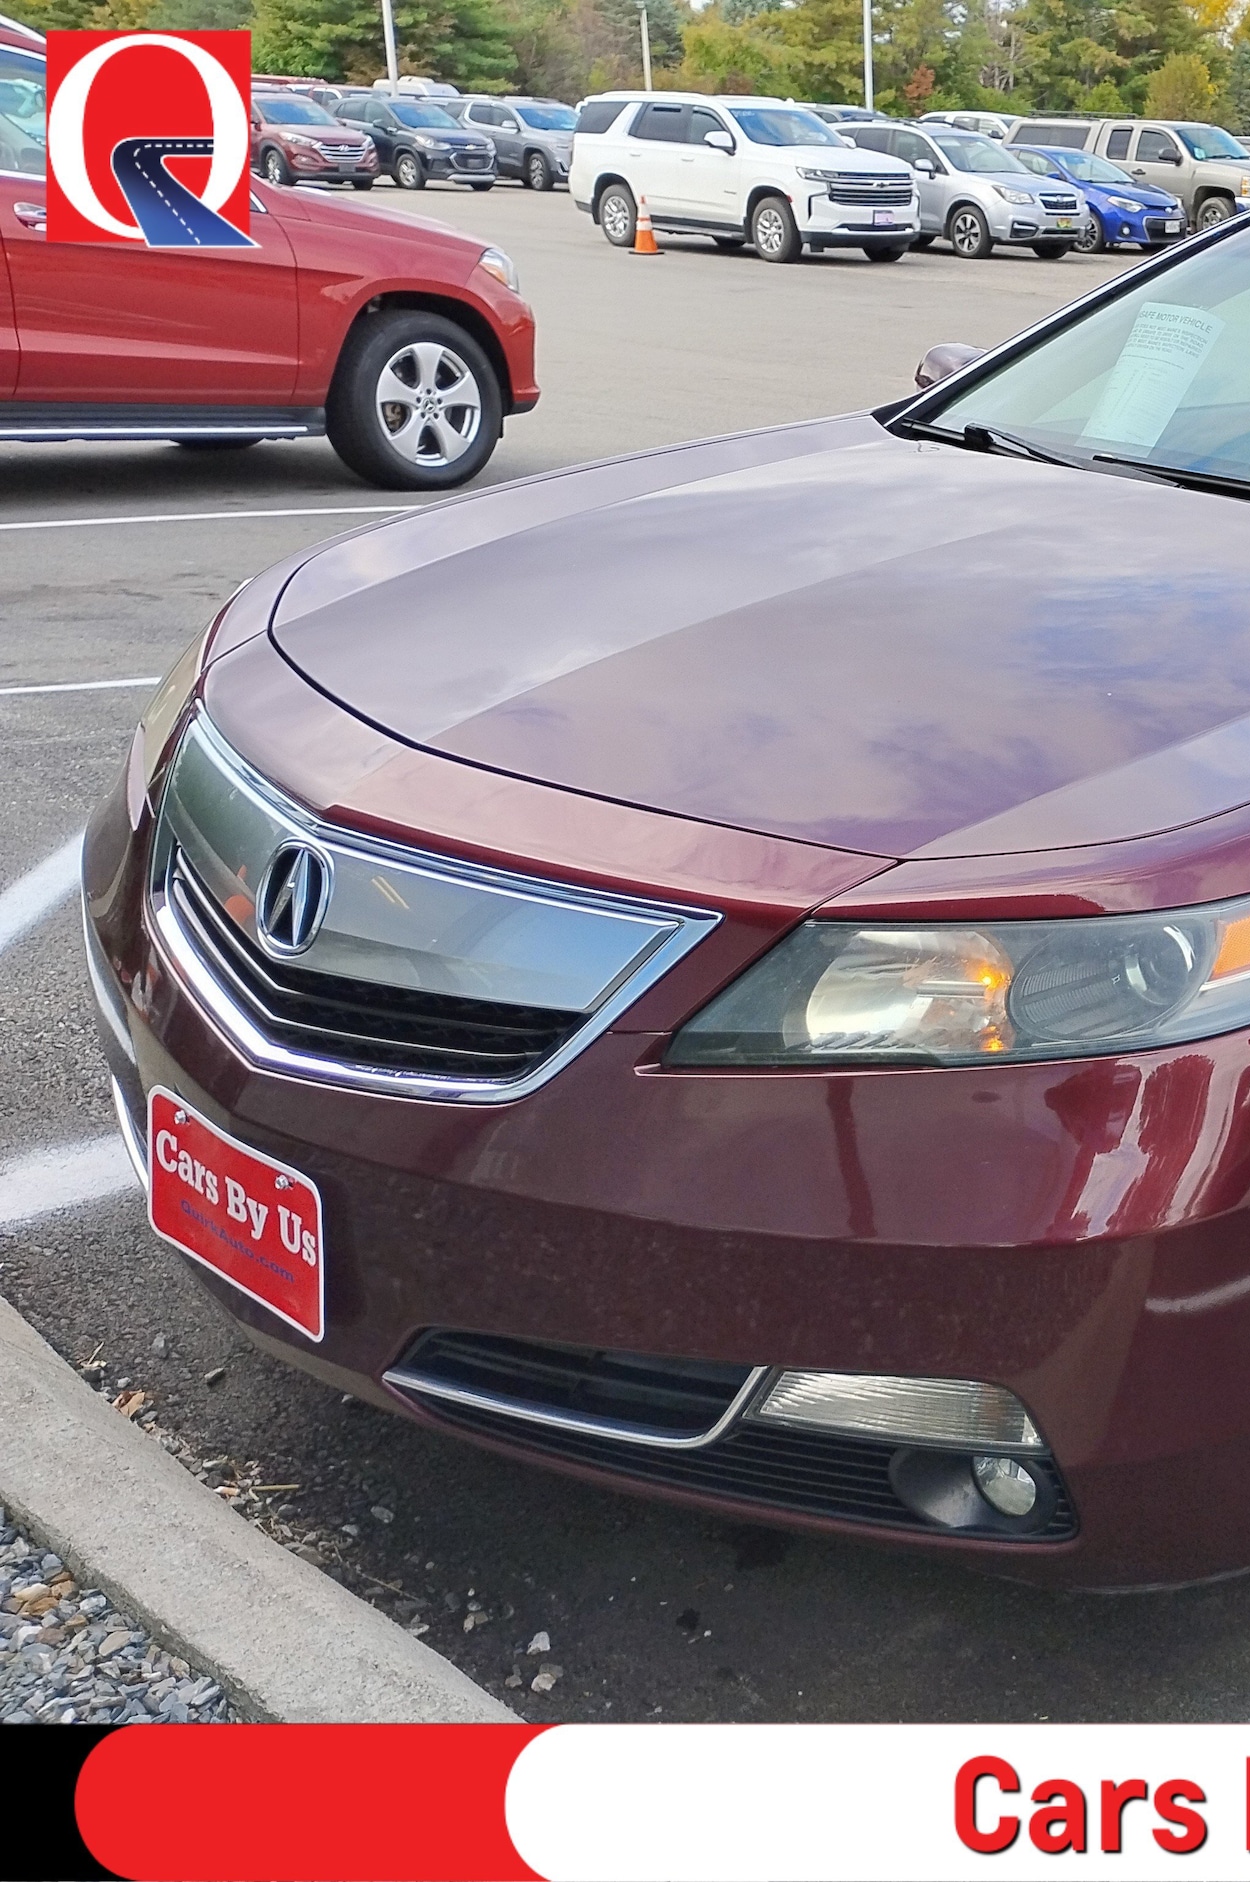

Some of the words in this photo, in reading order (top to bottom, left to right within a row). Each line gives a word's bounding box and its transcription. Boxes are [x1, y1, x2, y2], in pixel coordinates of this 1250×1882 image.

[1156, 312, 1180, 323] MOTOR
[1180, 315, 1213, 334] VEHICLE
[155, 1129, 219, 1205] Cars
[225, 1175, 269, 1240] By
[277, 1205, 316, 1267] Us
[181, 1199, 295, 1284] QuirkAuto.com
